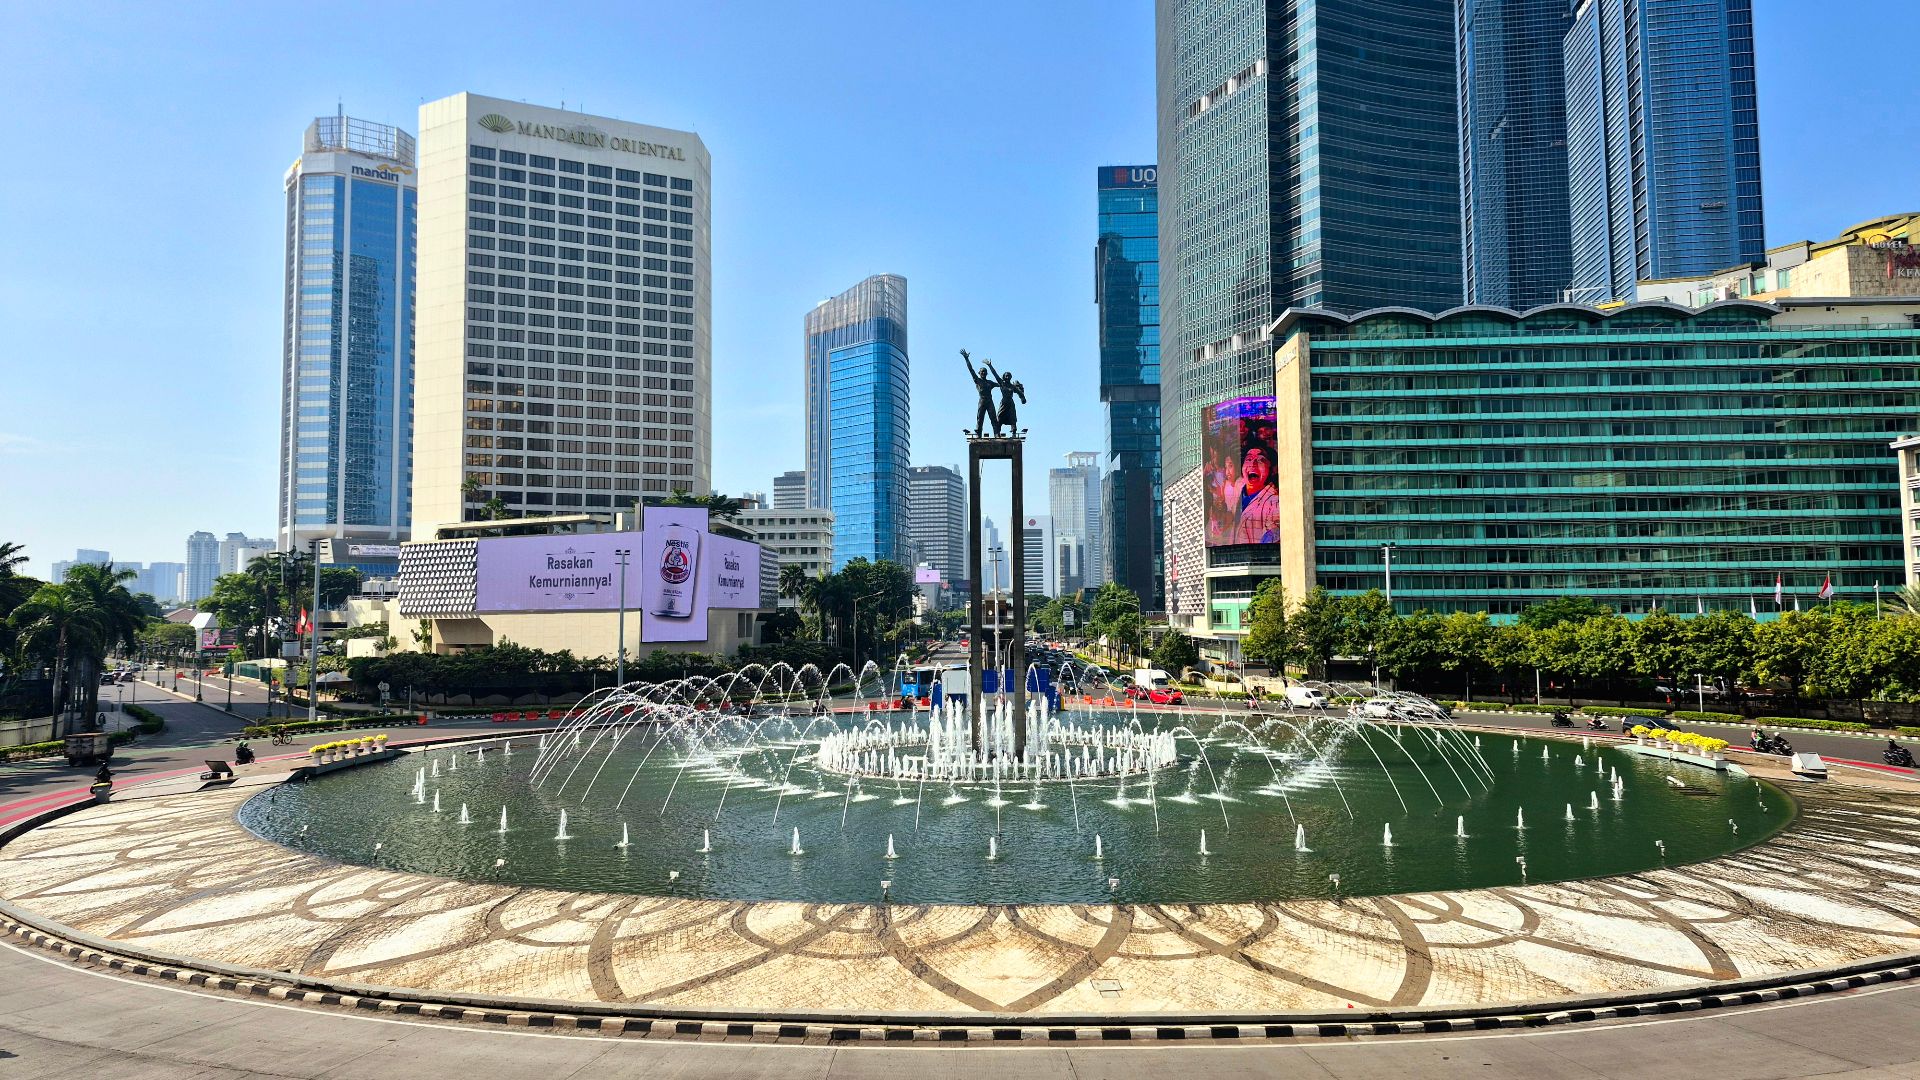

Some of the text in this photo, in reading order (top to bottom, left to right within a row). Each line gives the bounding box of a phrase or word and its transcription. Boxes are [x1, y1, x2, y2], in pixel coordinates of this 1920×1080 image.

[517, 120, 686, 161] MANDARIN ORIENTAL
[351, 165, 399, 182] mandiri
[547, 556, 593, 570] Rasakan
[529, 573, 612, 590] Kemurniannya!
